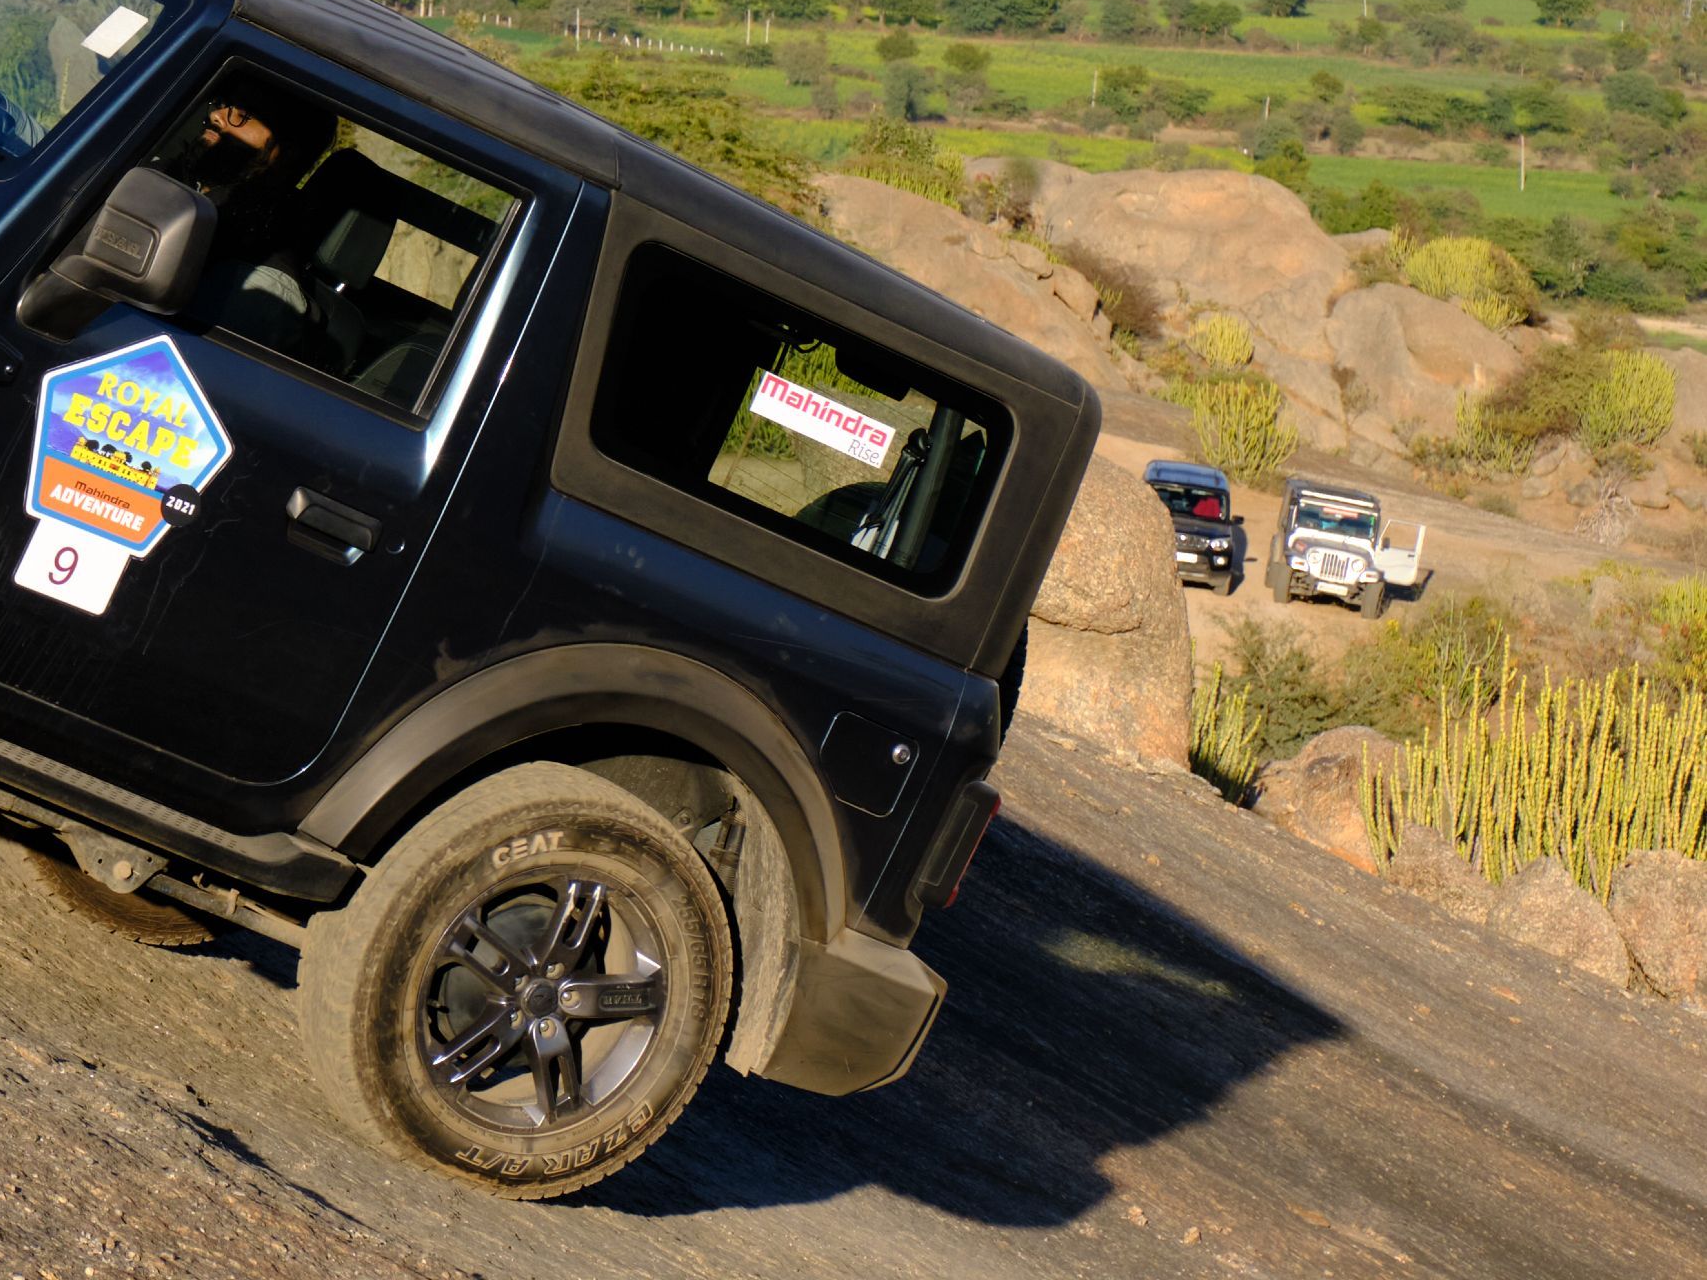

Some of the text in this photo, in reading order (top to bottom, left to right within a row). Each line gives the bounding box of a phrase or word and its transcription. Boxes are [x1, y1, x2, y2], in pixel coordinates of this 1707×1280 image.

[97, 372, 188, 429] ROYAL
[62, 392, 199, 470] ESCAPE
[847, 439, 880, 466] Rise.
[50, 484, 145, 532] ADVENTURE
[165, 495, 196, 516] 2021
[48, 546, 79, 585] 9
[492, 831, 564, 869] CEAT
[543, 1101, 654, 1175] CZAR
[455, 1145, 534, 1176] A/T
